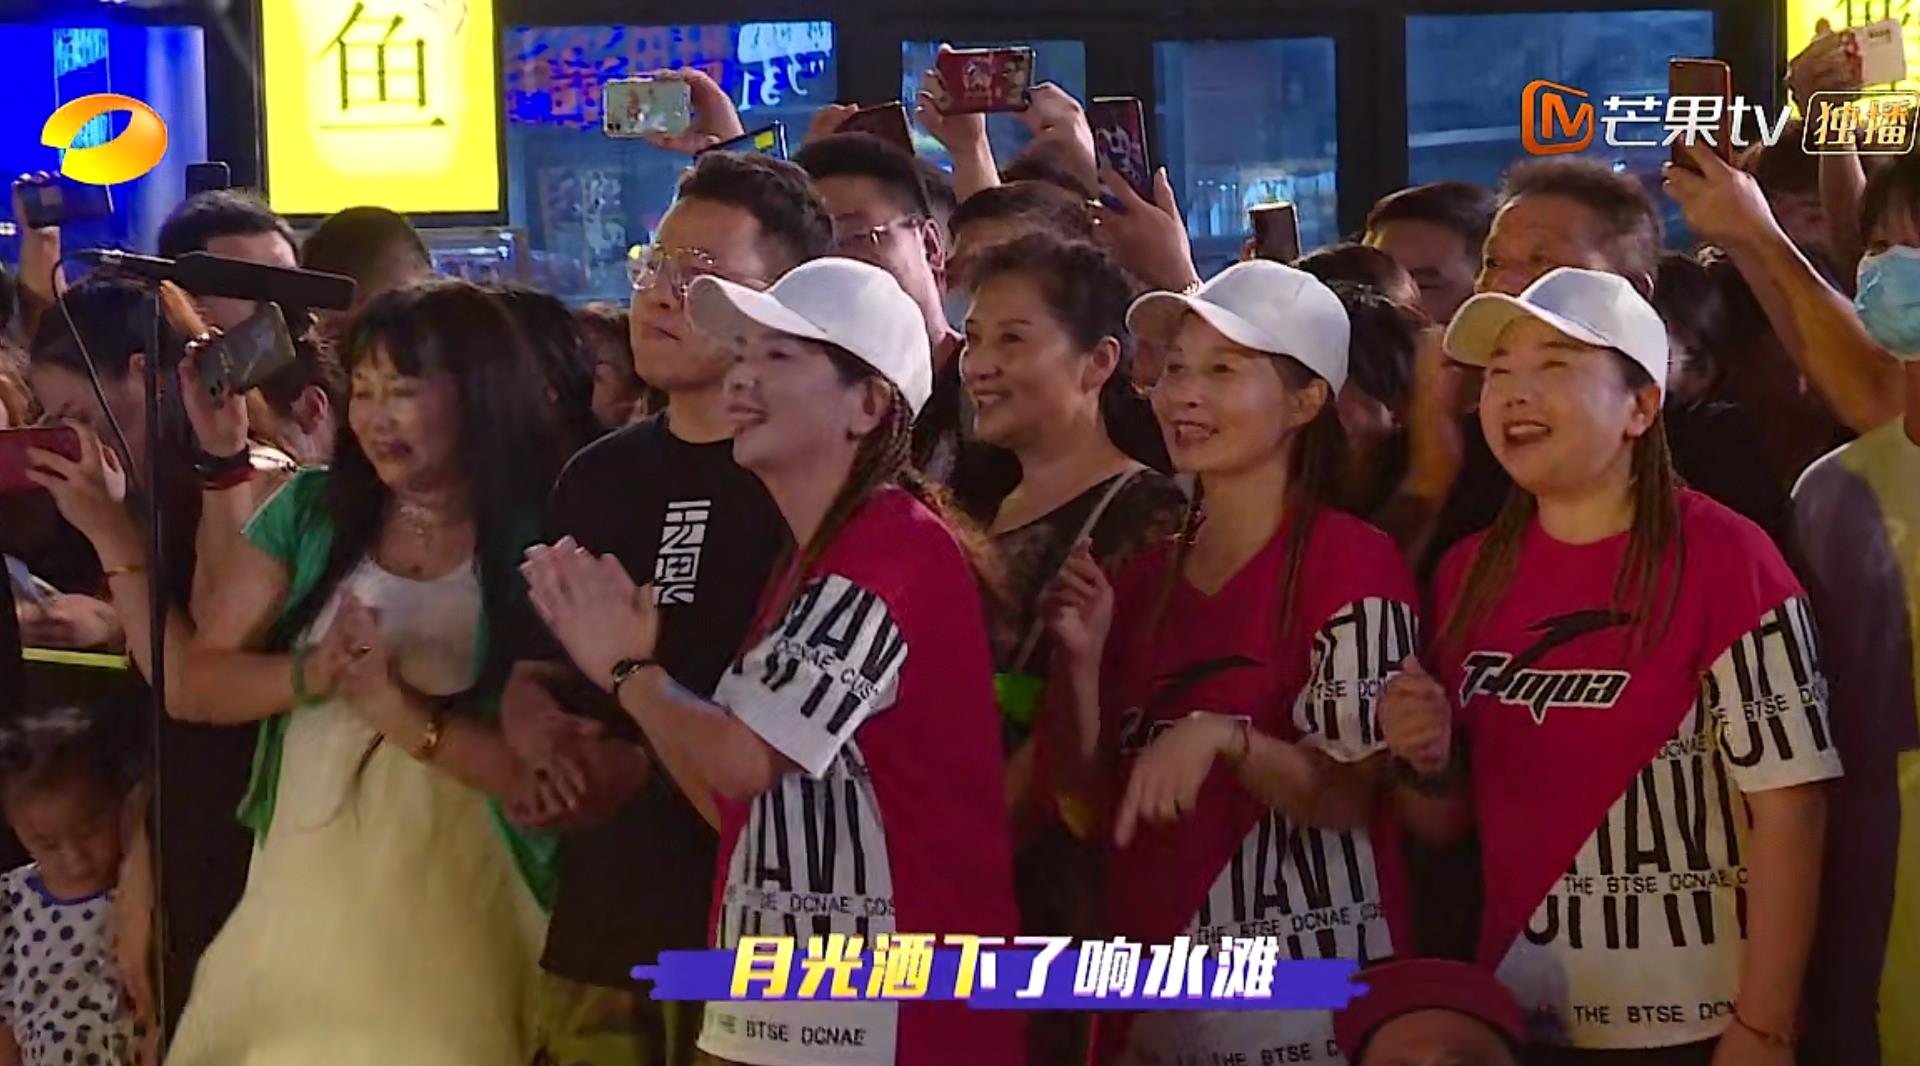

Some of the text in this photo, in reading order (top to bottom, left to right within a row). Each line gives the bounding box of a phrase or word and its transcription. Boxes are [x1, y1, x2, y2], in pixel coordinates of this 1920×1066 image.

[316, 2, 447, 131] 鱼
[1565, 876, 1594, 895] THE
[1573, 1005, 1611, 1025] THE
[1626, 1005, 1686, 1023] BTSE
